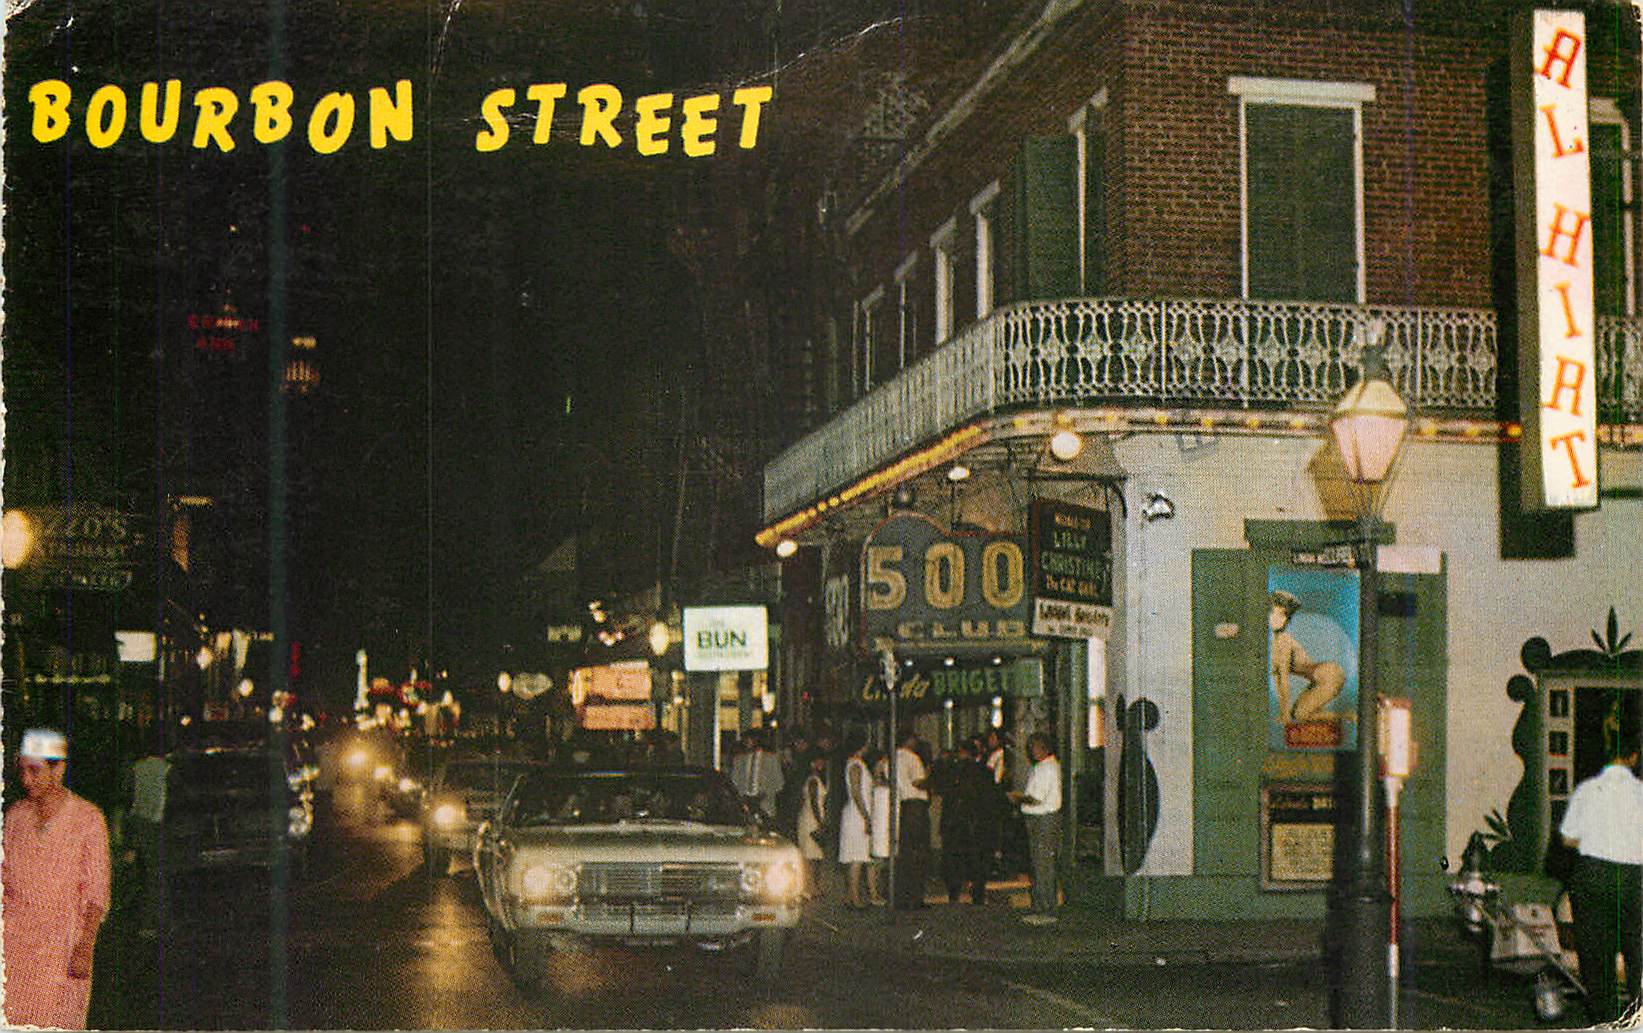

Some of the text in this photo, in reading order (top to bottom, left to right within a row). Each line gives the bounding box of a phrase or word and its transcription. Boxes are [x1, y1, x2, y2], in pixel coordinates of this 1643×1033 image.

[867, 541, 1025, 610] 500
[897, 620, 1026, 638] CLUB
[697, 630, 747, 649] BUN
